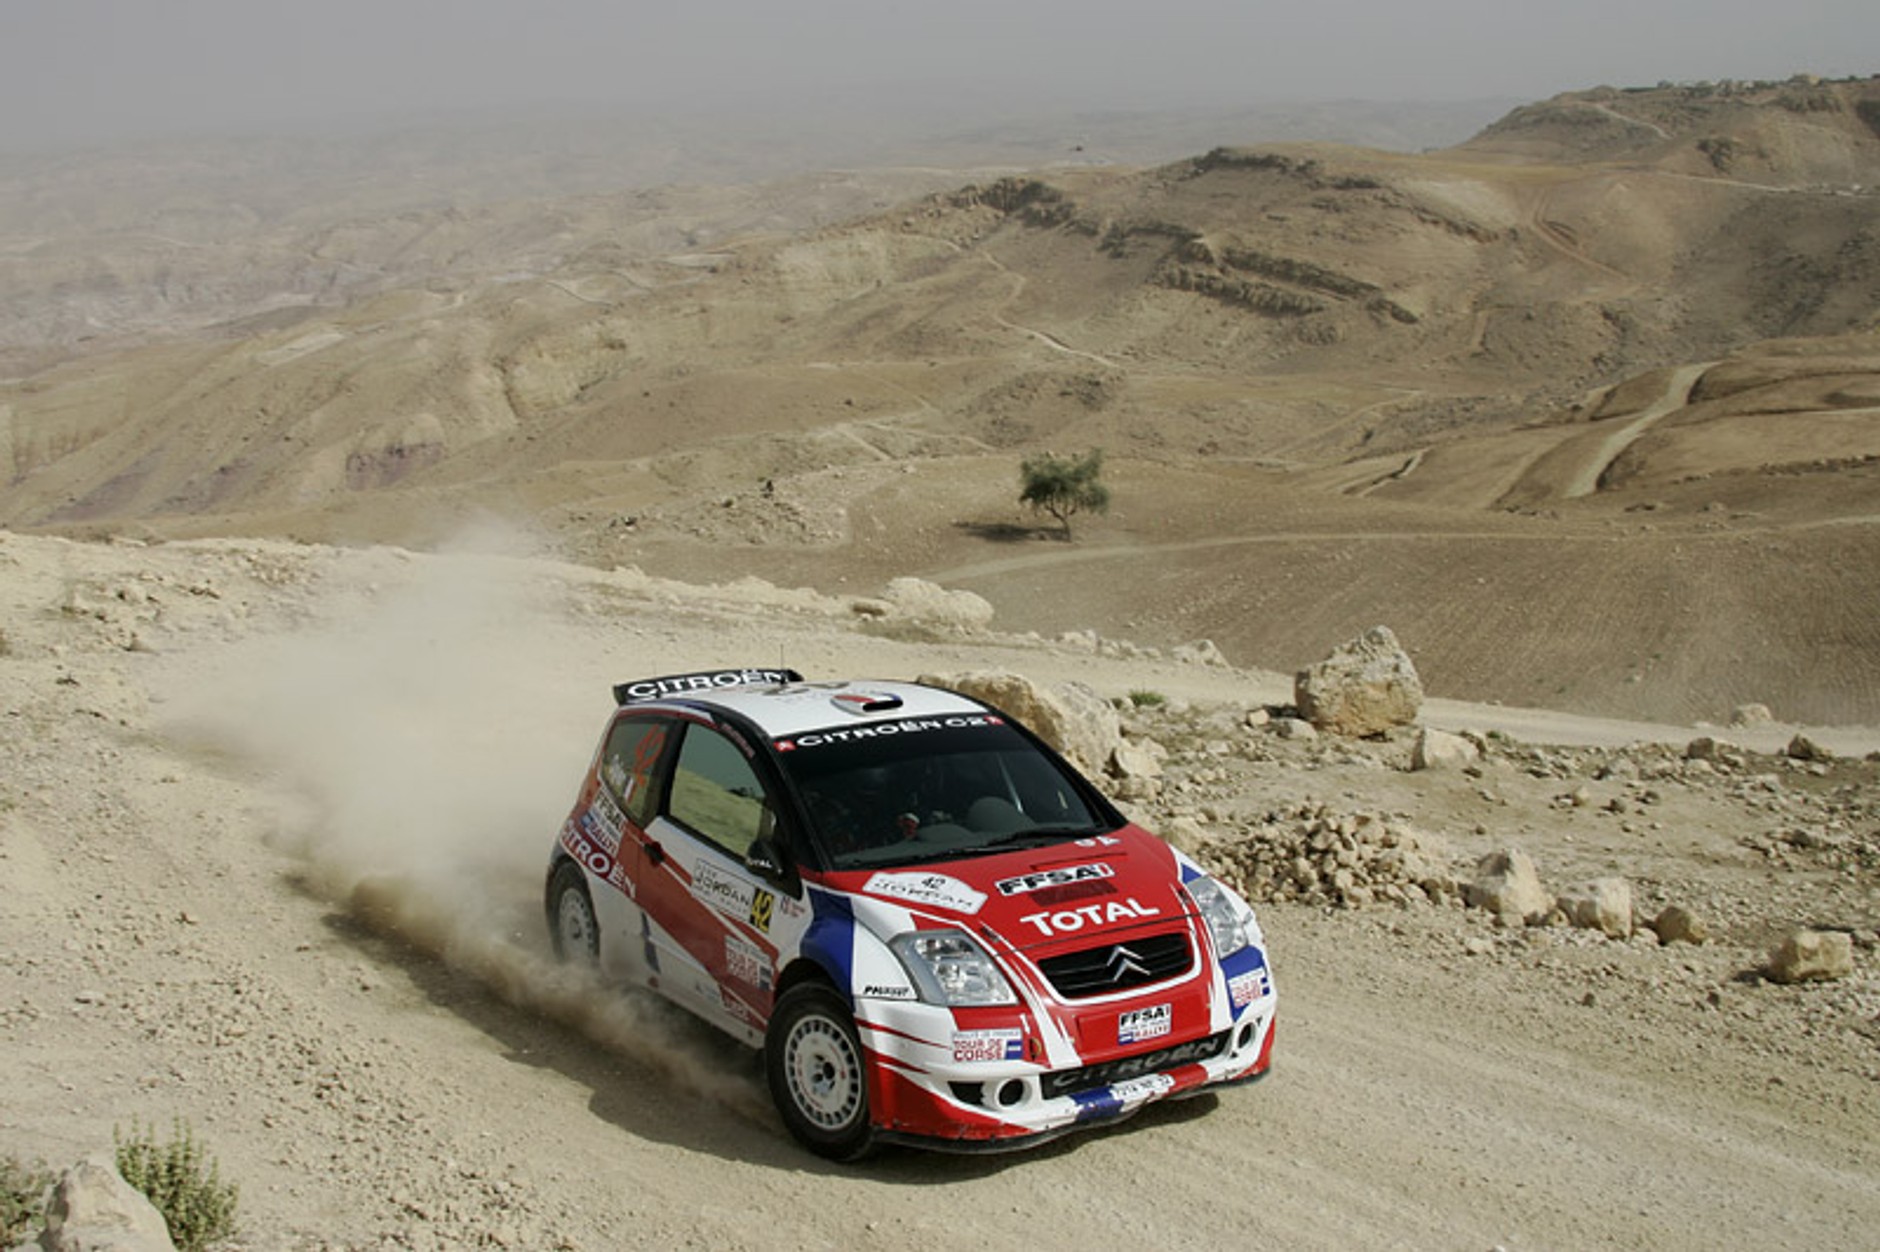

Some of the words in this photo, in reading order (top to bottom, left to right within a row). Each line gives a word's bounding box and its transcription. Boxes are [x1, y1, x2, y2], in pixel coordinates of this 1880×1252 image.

[627, 668, 788, 697] CITROËN
[796, 720, 942, 746] CITROËN
[945, 717, 988, 728] C2
[696, 870, 750, 907] JORDAN
[922, 876, 946, 889] 42
[998, 865, 1112, 894] FFSA
[874, 882, 973, 907] JORDAN
[751, 890, 774, 933] 42
[1019, 897, 1161, 936] TOTAL
[1121, 1006, 1165, 1026] FFSA
[953, 1039, 985, 1050] TOUR
[988, 1038, 1003, 1049] DE
[954, 1049, 1003, 1062] CORSE
